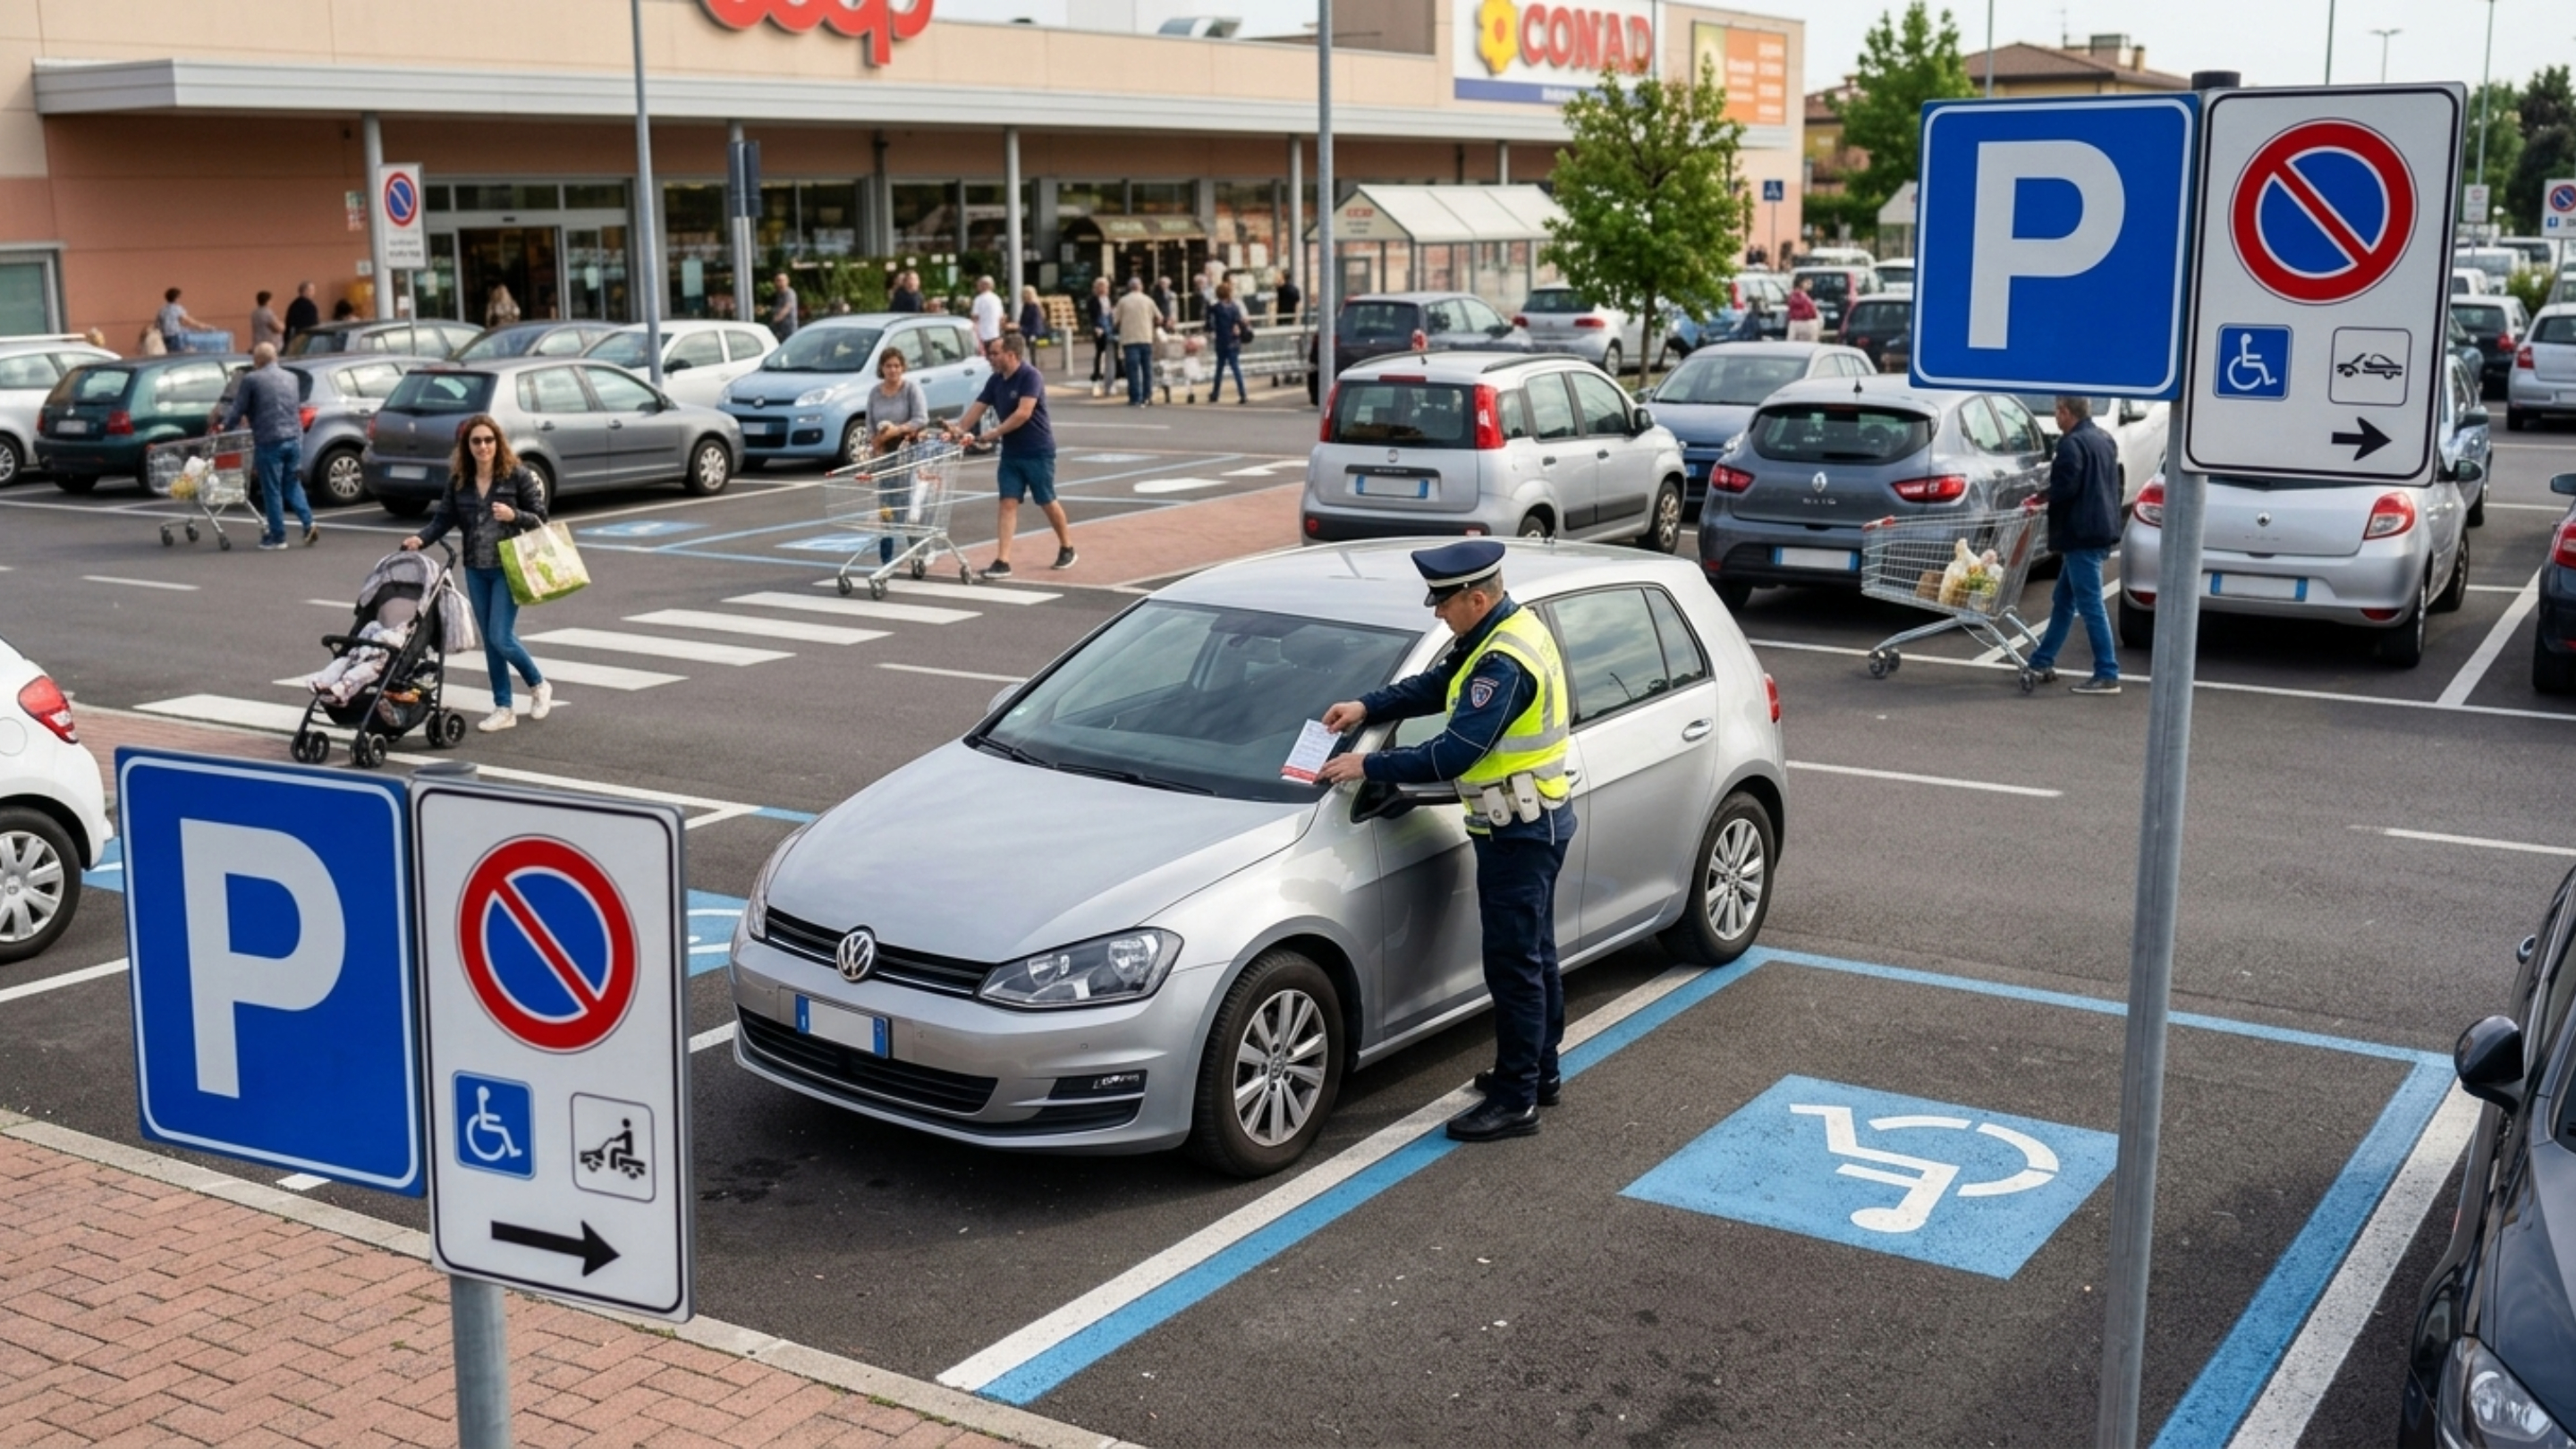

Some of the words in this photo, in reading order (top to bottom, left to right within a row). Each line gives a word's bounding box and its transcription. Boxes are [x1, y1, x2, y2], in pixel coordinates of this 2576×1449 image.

[1521, 4, 1651, 75] CONAD
[1969, 140, 2124, 349] P
[180, 818, 345, 1098] P
